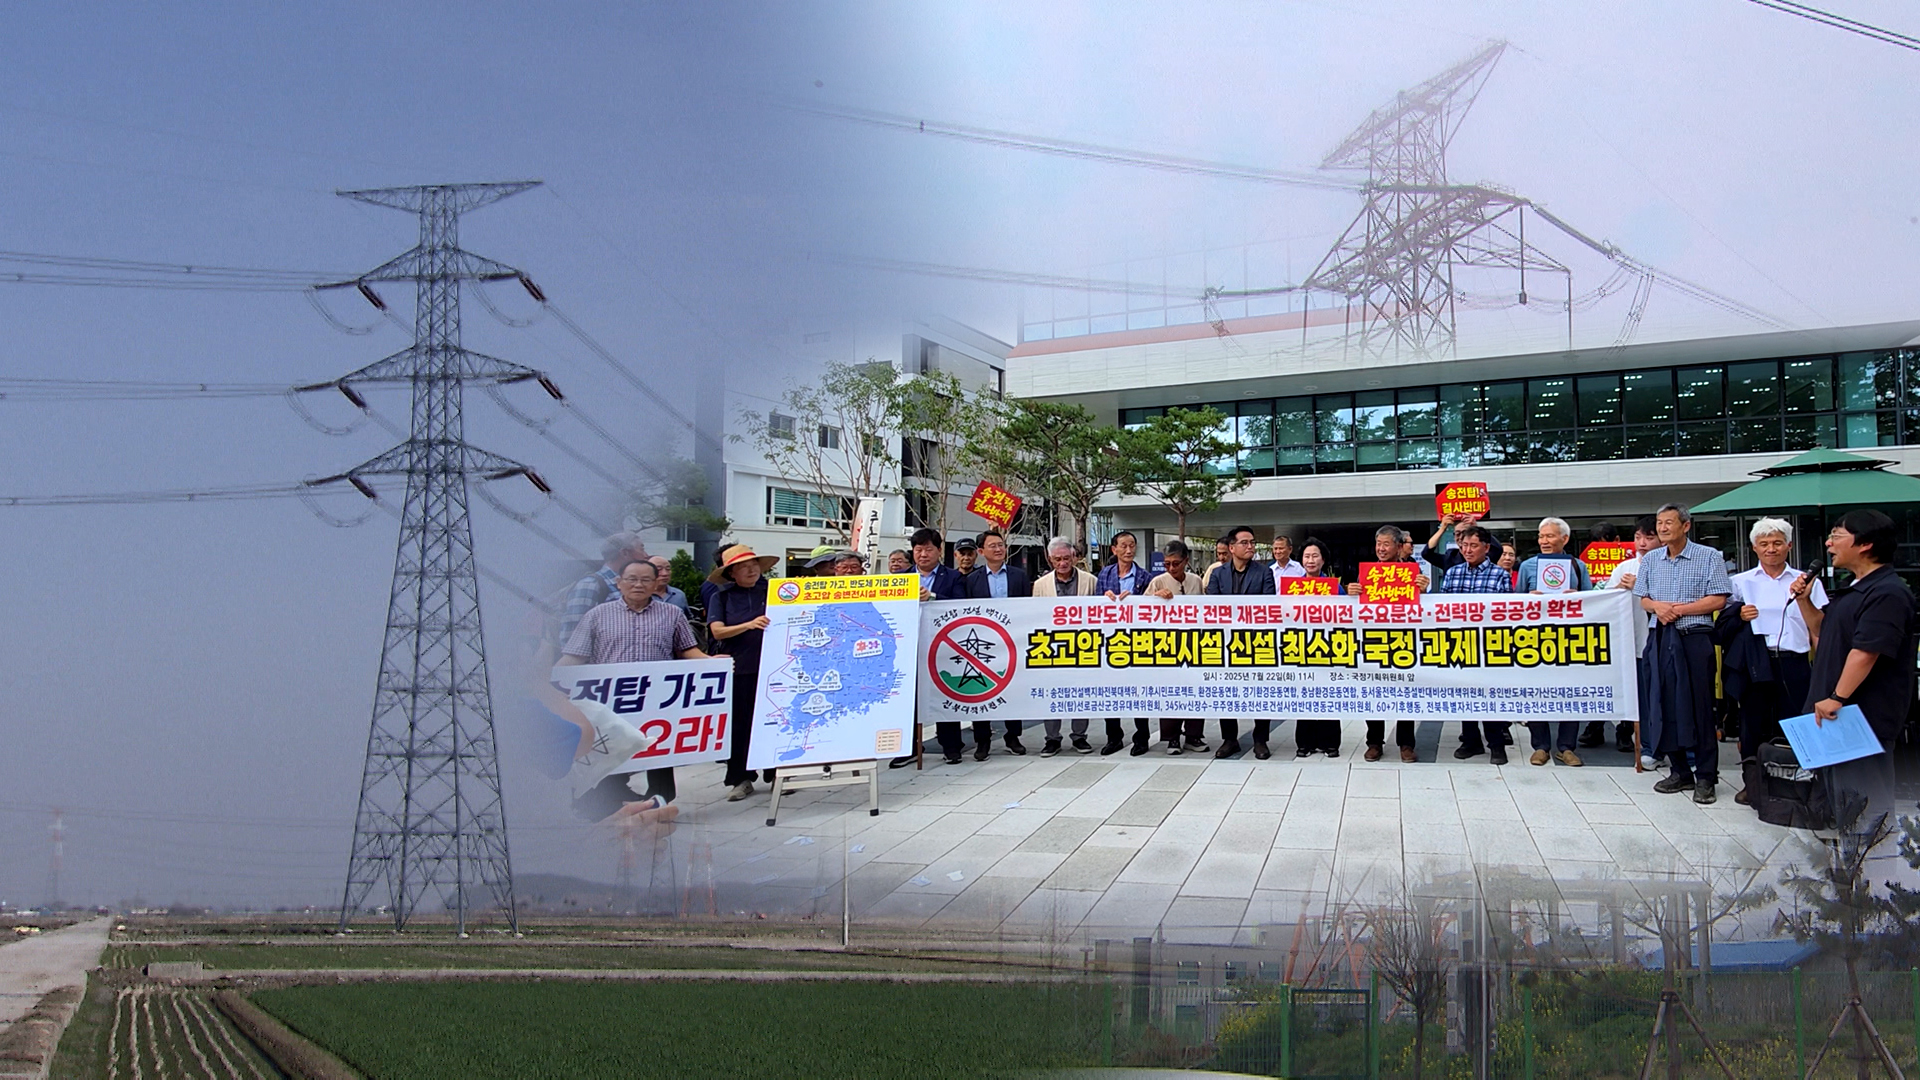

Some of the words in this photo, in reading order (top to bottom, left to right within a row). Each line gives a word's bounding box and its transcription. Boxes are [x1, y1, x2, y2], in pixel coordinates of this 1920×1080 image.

[980, 487, 1015, 511] 송전탑
[1446, 487, 1480, 500] 송전탑!
[1441, 501, 1486, 514] 결사반대!
[1587, 548, 1626, 560] 송전탑!
[1366, 565, 1413, 583] 송전탑
[803, 581, 827, 591] 송전탑
[829, 580, 848, 589] 가고,
[849, 579, 873, 589] 반도체
[874, 578, 890, 588] 기업
[891, 577, 909, 587] 오라!
[1287, 580, 1332, 595] 송전탑
[803, 591, 831, 601] 초고압
[833, 590, 877, 600] 송변전시설
[879, 588, 909, 598] 백지화!
[1365, 583, 1415, 602] 결사반대
[932, 608, 959, 628] 송전탑
[962, 605, 982, 616] 건설
[985, 607, 1012, 626] 백지화
[1052, 605, 1083, 626] 용인
[1087, 604, 1134, 625] 반도체
[1138, 604, 1199, 624] 국가산단
[1203, 604, 1232, 624] 전면
[1490, 602, 1542, 621] 공공성
[1546, 599, 1584, 619] 확보
[1027, 629, 1103, 667] 초고압
[1107, 629, 1223, 667] 송변전시설
[1228, 630, 1276, 667] 신설
[1282, 629, 1358, 667] 최소화
[1363, 629, 1417, 667] 국정
[1421, 627, 1478, 666] 과제
[1485, 624, 1609, 665] 반영하라!
[1203, 672, 1217, 681] 일시
[1224, 672, 1250, 681] 2025년
[1251, 672, 1264, 681] 7월
[1266, 672, 1296, 682] 22일(화)
[1298, 672, 1315, 681] 11시
[1329, 672, 1345, 681] 장소
[1351, 673, 1405, 681] 국정기획위원회
[1407, 673, 1415, 682] 앞
[550, 676, 652, 714] 전탑
[659, 671, 728, 709] 가고
[1030, 687, 1045, 699] 주최
[1198, 686, 1241, 698] 환경운동연합,
[1242, 686, 1299, 698] 경기환경운동연합,
[1301, 686, 1359, 698] 충남환경운동연합,
[1489, 686, 1613, 699] 용인반도체국가산단재검토요구모임
[1376, 701, 1424, 713] 60+기후행동,
[1426, 701, 1497, 713] 전북특별자치도의회
[1499, 701, 1614, 713] 초고압송전선로대책특별위원회
[631, 713, 729, 759] 오라!
